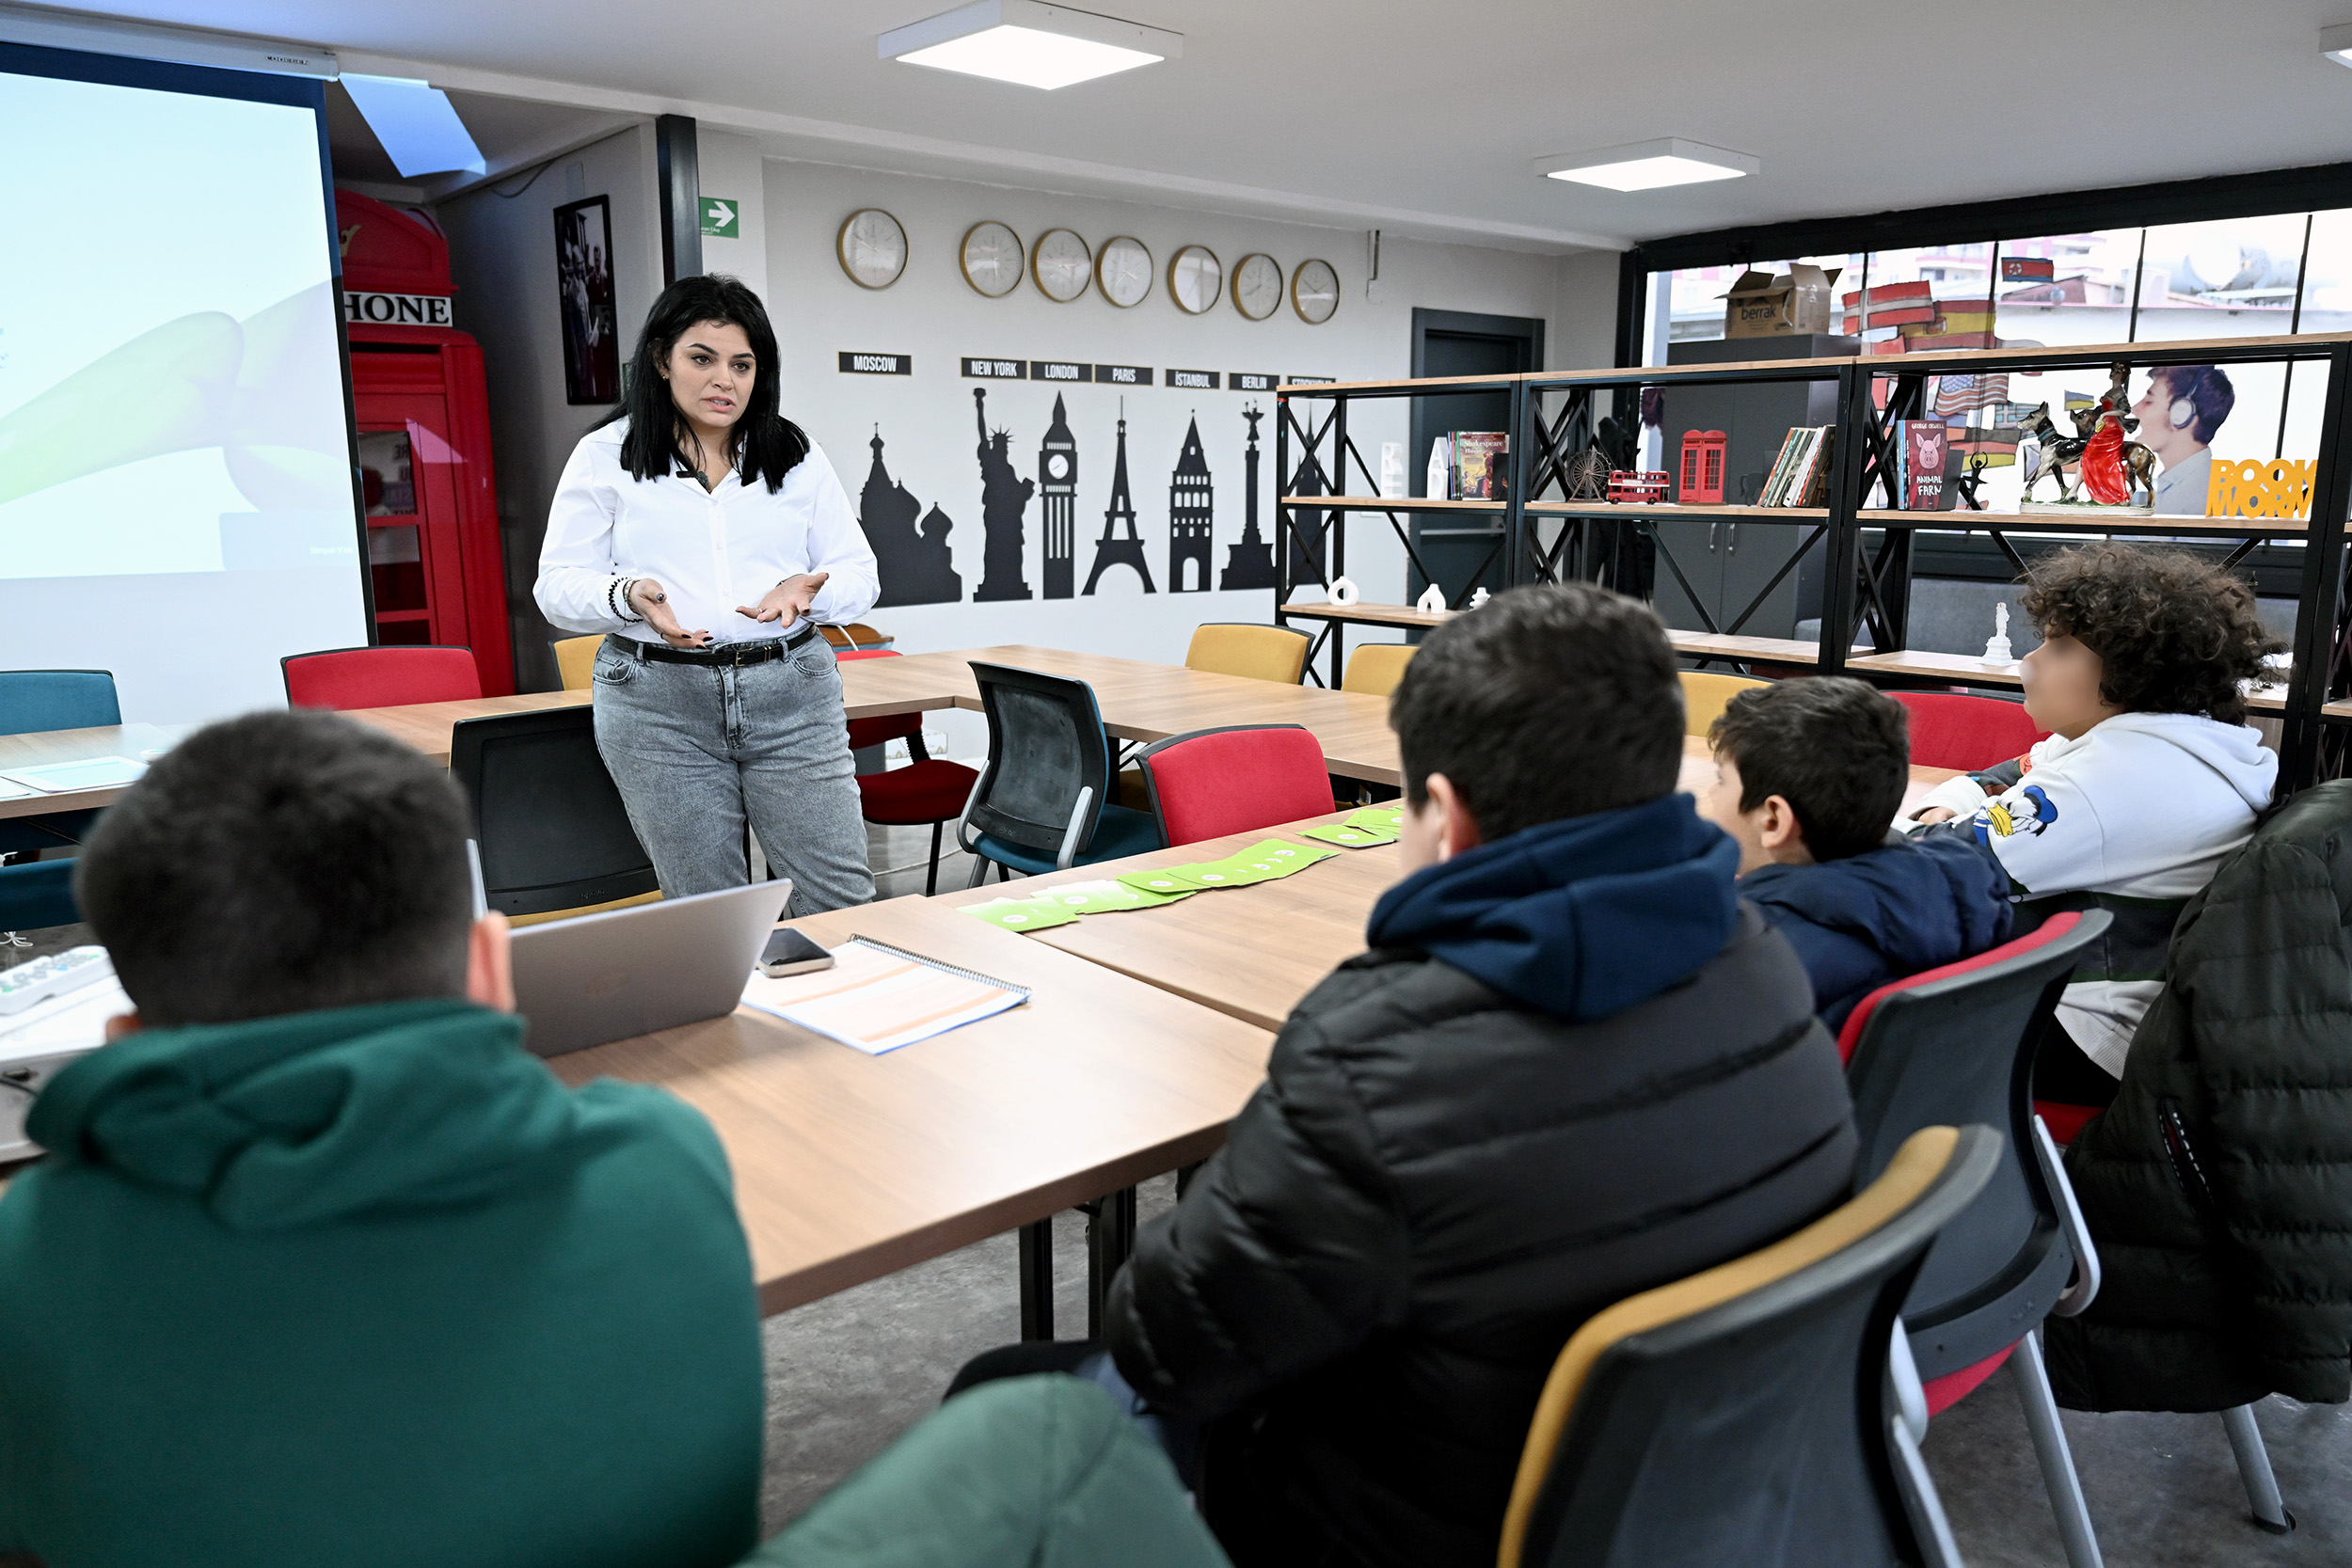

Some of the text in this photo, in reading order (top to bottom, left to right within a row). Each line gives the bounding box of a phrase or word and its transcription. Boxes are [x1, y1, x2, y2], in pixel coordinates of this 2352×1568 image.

[1741, 305, 1776, 321] berrak
[853, 355, 898, 372] MOSCOW
[971, 360, 1017, 377] NEW YORK
[1044, 364, 1079, 380] LONDON
[1112, 368, 1136, 383] PARIS
[1241, 375, 1267, 389] BERLIN
[1464, 439, 1503, 448] Shakespeare
[1916, 475, 1943, 483] ANIMAL
